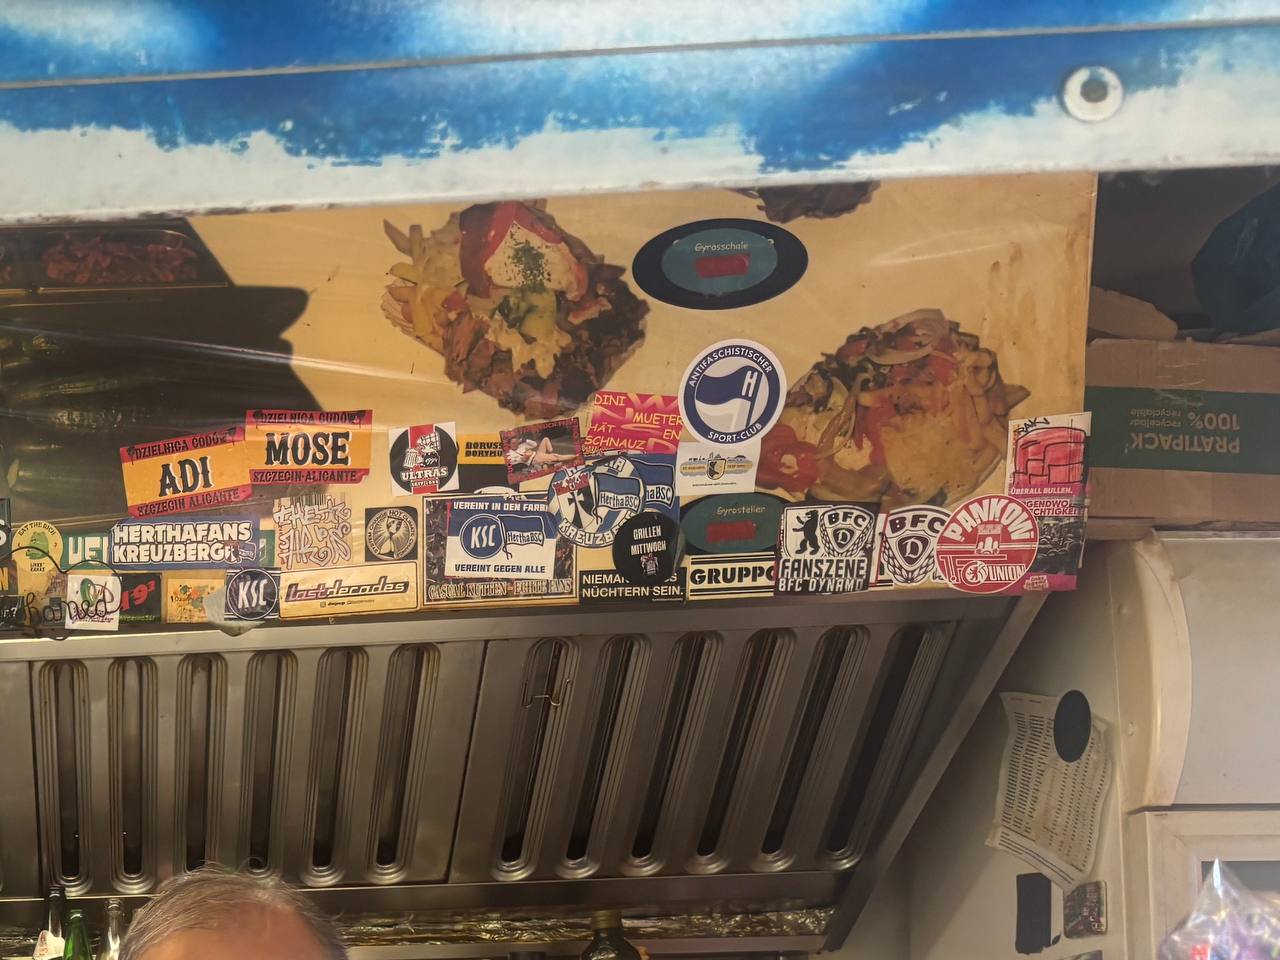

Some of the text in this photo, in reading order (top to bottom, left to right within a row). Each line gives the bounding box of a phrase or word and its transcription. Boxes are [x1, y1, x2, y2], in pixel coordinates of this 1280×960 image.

[688, 347, 773, 388] ANTIFASCHISTISCHER
[741, 370, 758, 398] H
[594, 394, 627, 406] DINI
[590, 421, 616, 433] HÄT
[707, 422, 762, 442] SPORT-CLUB
[1187, 413, 1240, 431] 100%
[265, 430, 352, 466] MOSE
[584, 435, 647, 450] SCHNAUZ
[1130, 432, 1240, 454] PRATIPACK
[158, 456, 214, 498] ADI
[1010, 486, 1042, 495] ÜBERALL
[453, 501, 489, 511] VEREINT
[491, 502, 501, 511] IN
[503, 502, 521, 511] DEN
[827, 511, 867, 528] BFC
[889, 515, 946, 535] BFC
[943, 498, 1035, 543] PANKOW
[114, 521, 252, 544] HERTHAFANS
[470, 524, 496, 549] KSC
[632, 525, 662, 541] GRILLEN
[113, 543, 225, 563] KREUZBERG
[454, 563, 546, 574] VEREINT GEGEN ALLE
[781, 558, 866, 579] FANSZENE
[986, 564, 1027, 581] UNION
[237, 578, 269, 609] KSC
[581, 585, 684, 598] NÜCHTERN SEIN.
[778, 578, 864, 592] BFC DYNAMO
